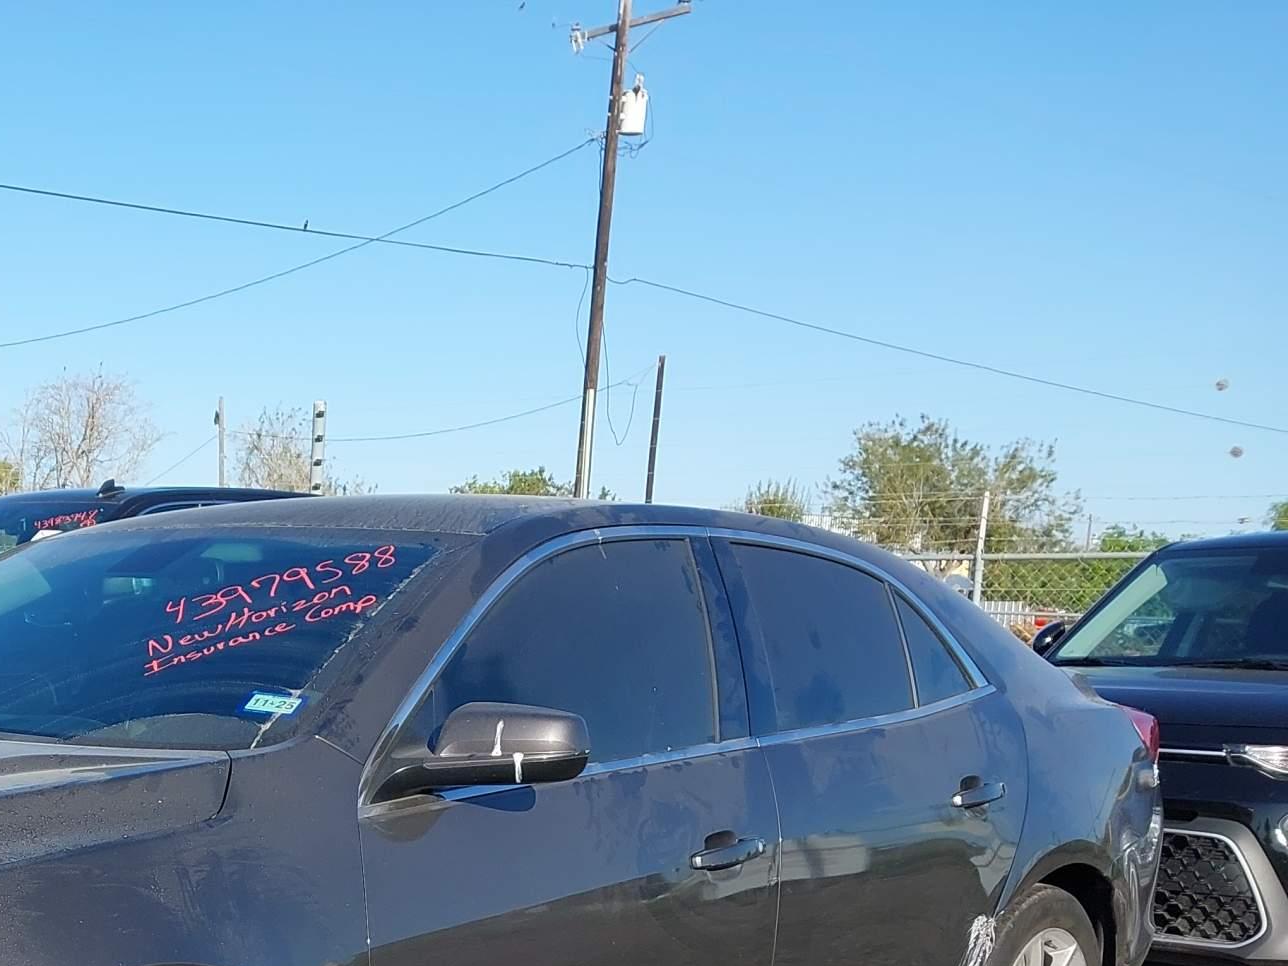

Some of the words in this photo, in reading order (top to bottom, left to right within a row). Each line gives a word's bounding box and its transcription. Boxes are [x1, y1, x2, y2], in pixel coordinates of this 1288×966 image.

[165, 543, 397, 624] 43979588
[143, 621, 297, 677] Insurance
[304, 594, 377, 622] Comp
